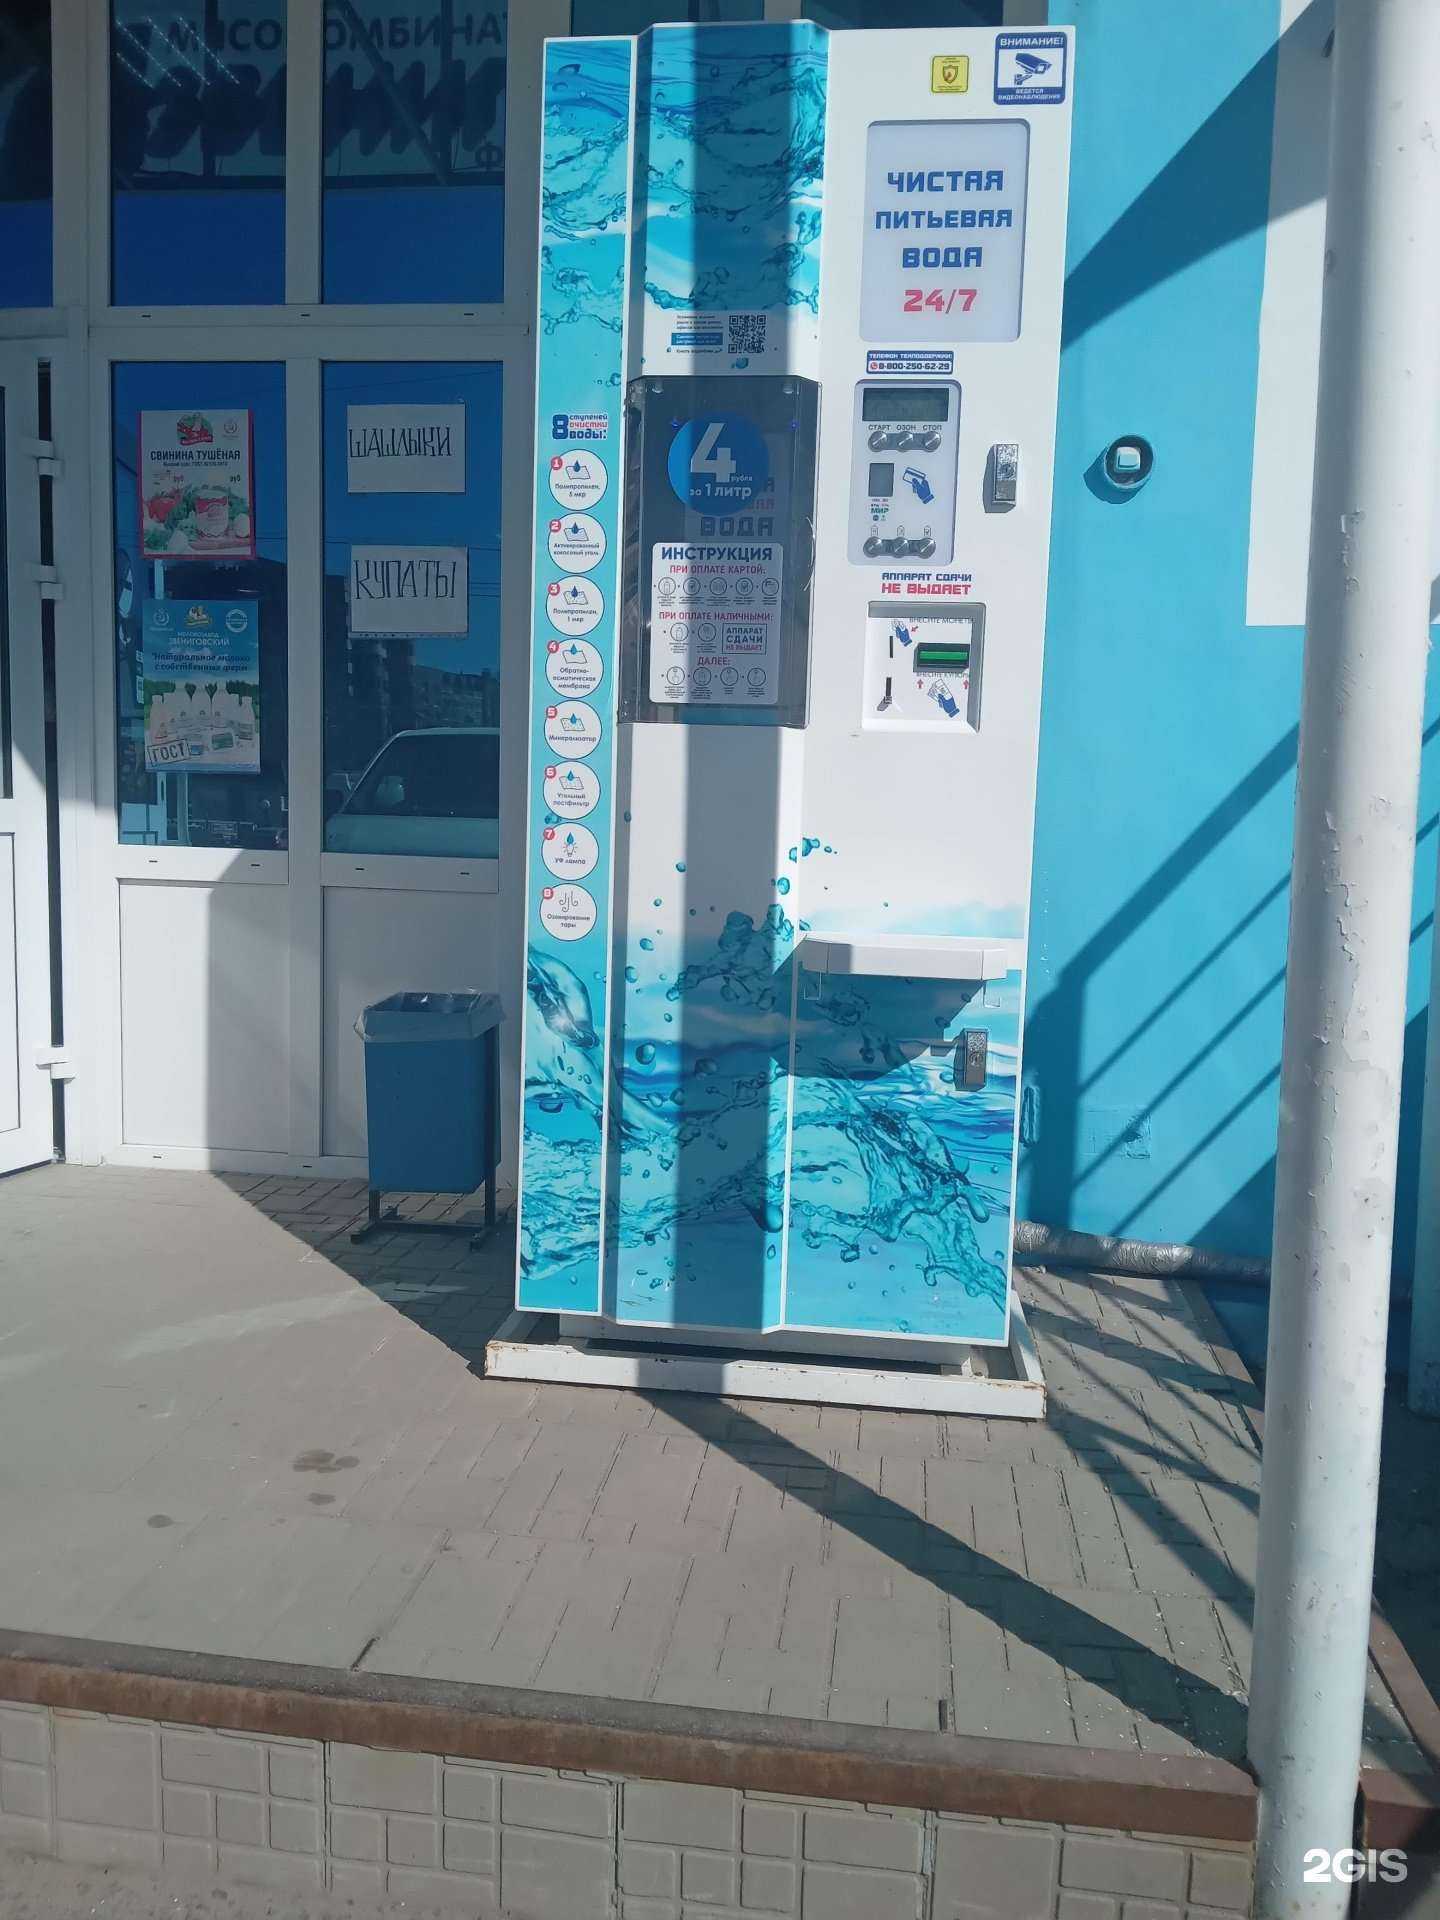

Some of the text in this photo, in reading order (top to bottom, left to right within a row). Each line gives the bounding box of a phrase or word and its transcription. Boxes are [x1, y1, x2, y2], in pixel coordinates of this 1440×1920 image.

[1000, 37, 1064, 46] ВНИМАНИЕ!
[887, 170, 1004, 192] ЧИСТАЯ
[875, 209, 1013, 230] ПИТЬЕВАЯ
[902, 246, 983, 268] ВОДА
[903, 288, 978, 314] 24/7
[552, 414, 569, 439] 8
[569, 429, 607, 439] воды:
[349, 426, 453, 458] ШАШЛЫКИ
[150, 447, 241, 461] СВИНИНА ТУШЁНАЯ
[690, 422, 737, 483] 4
[705, 483, 711, 497] 1
[714, 486, 752, 500] литр
[551, 521, 559, 530] 2
[661, 547, 773, 563] ИНСТРУКЦИЯ
[669, 564, 766, 575] ПРИ ОПЛАТЕ КАРТОЙ:
[353, 560, 457, 600] КУПАТЫ
[881, 572, 972, 582] АППАРАТ СДАЧИ
[550, 585, 558, 593] 3
[881, 583, 972, 595] НЕ ВЫДАЕТ
[659, 611, 773, 621] ПРИ ОПЛАТЕ НАЛИЧНЫМИ:
[726, 635, 763, 643] СДАЧИ
[549, 642, 557, 651] 4
[697, 657, 731, 667] ДАЛЕЕ:
[548, 708, 555, 717] 5
[151, 742, 186, 762] ГОСТ
[546, 830, 552, 838] 7
